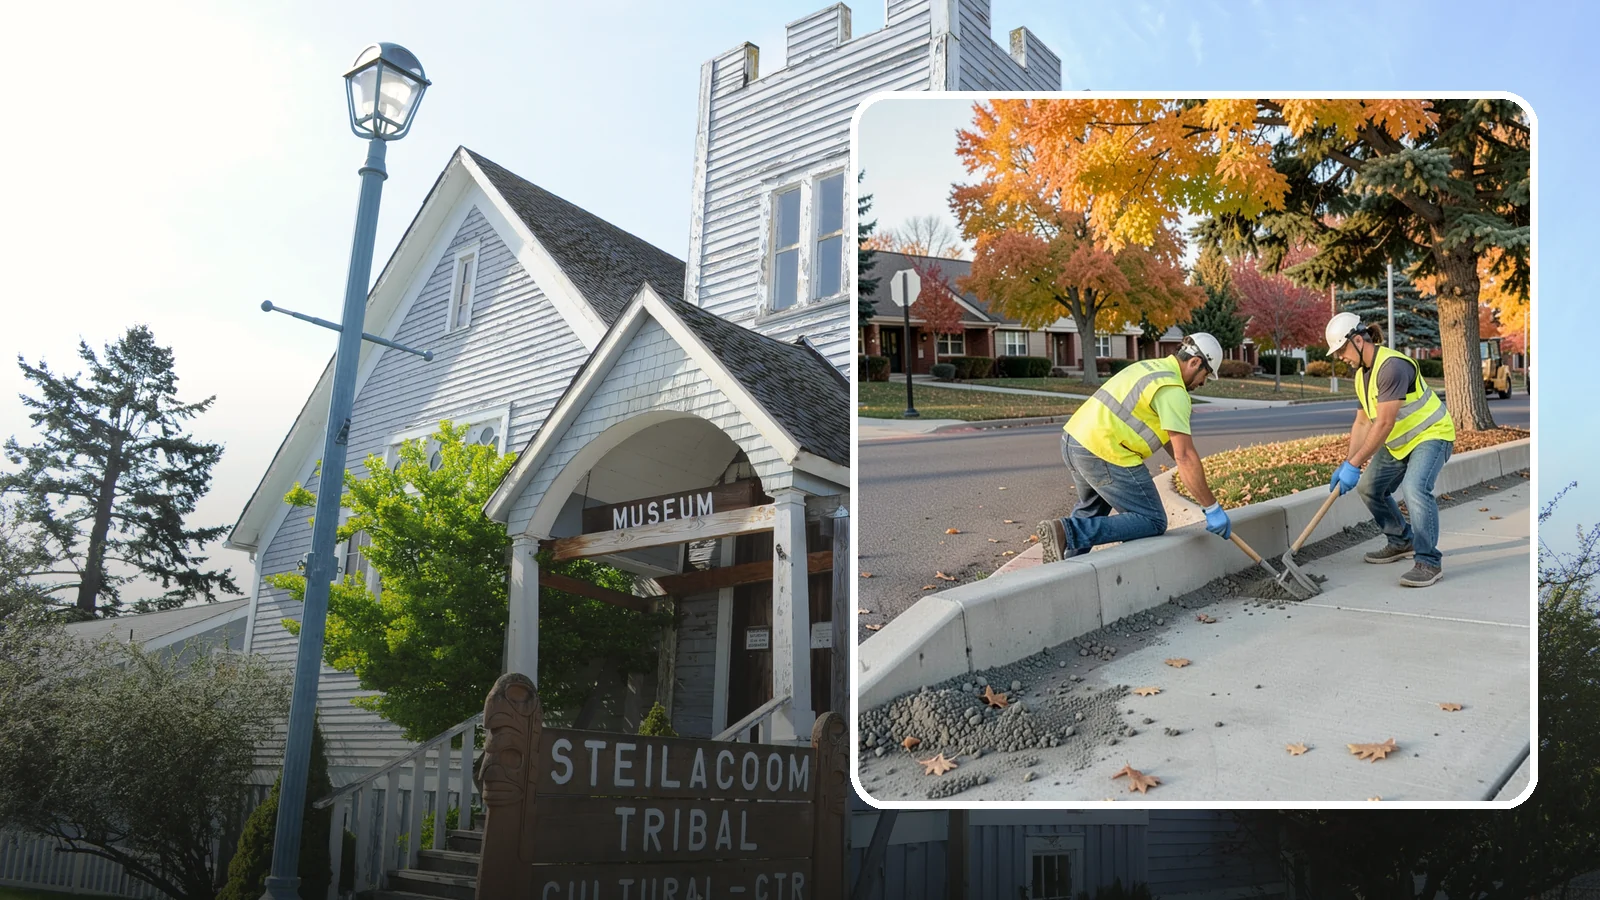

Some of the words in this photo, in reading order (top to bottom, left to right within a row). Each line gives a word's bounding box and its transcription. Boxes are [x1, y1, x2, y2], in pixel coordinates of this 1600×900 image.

[612, 491, 714, 531] MUSEUM
[550, 738, 810, 793] STEILACOOM
[615, 806, 758, 852] TRIBAL
